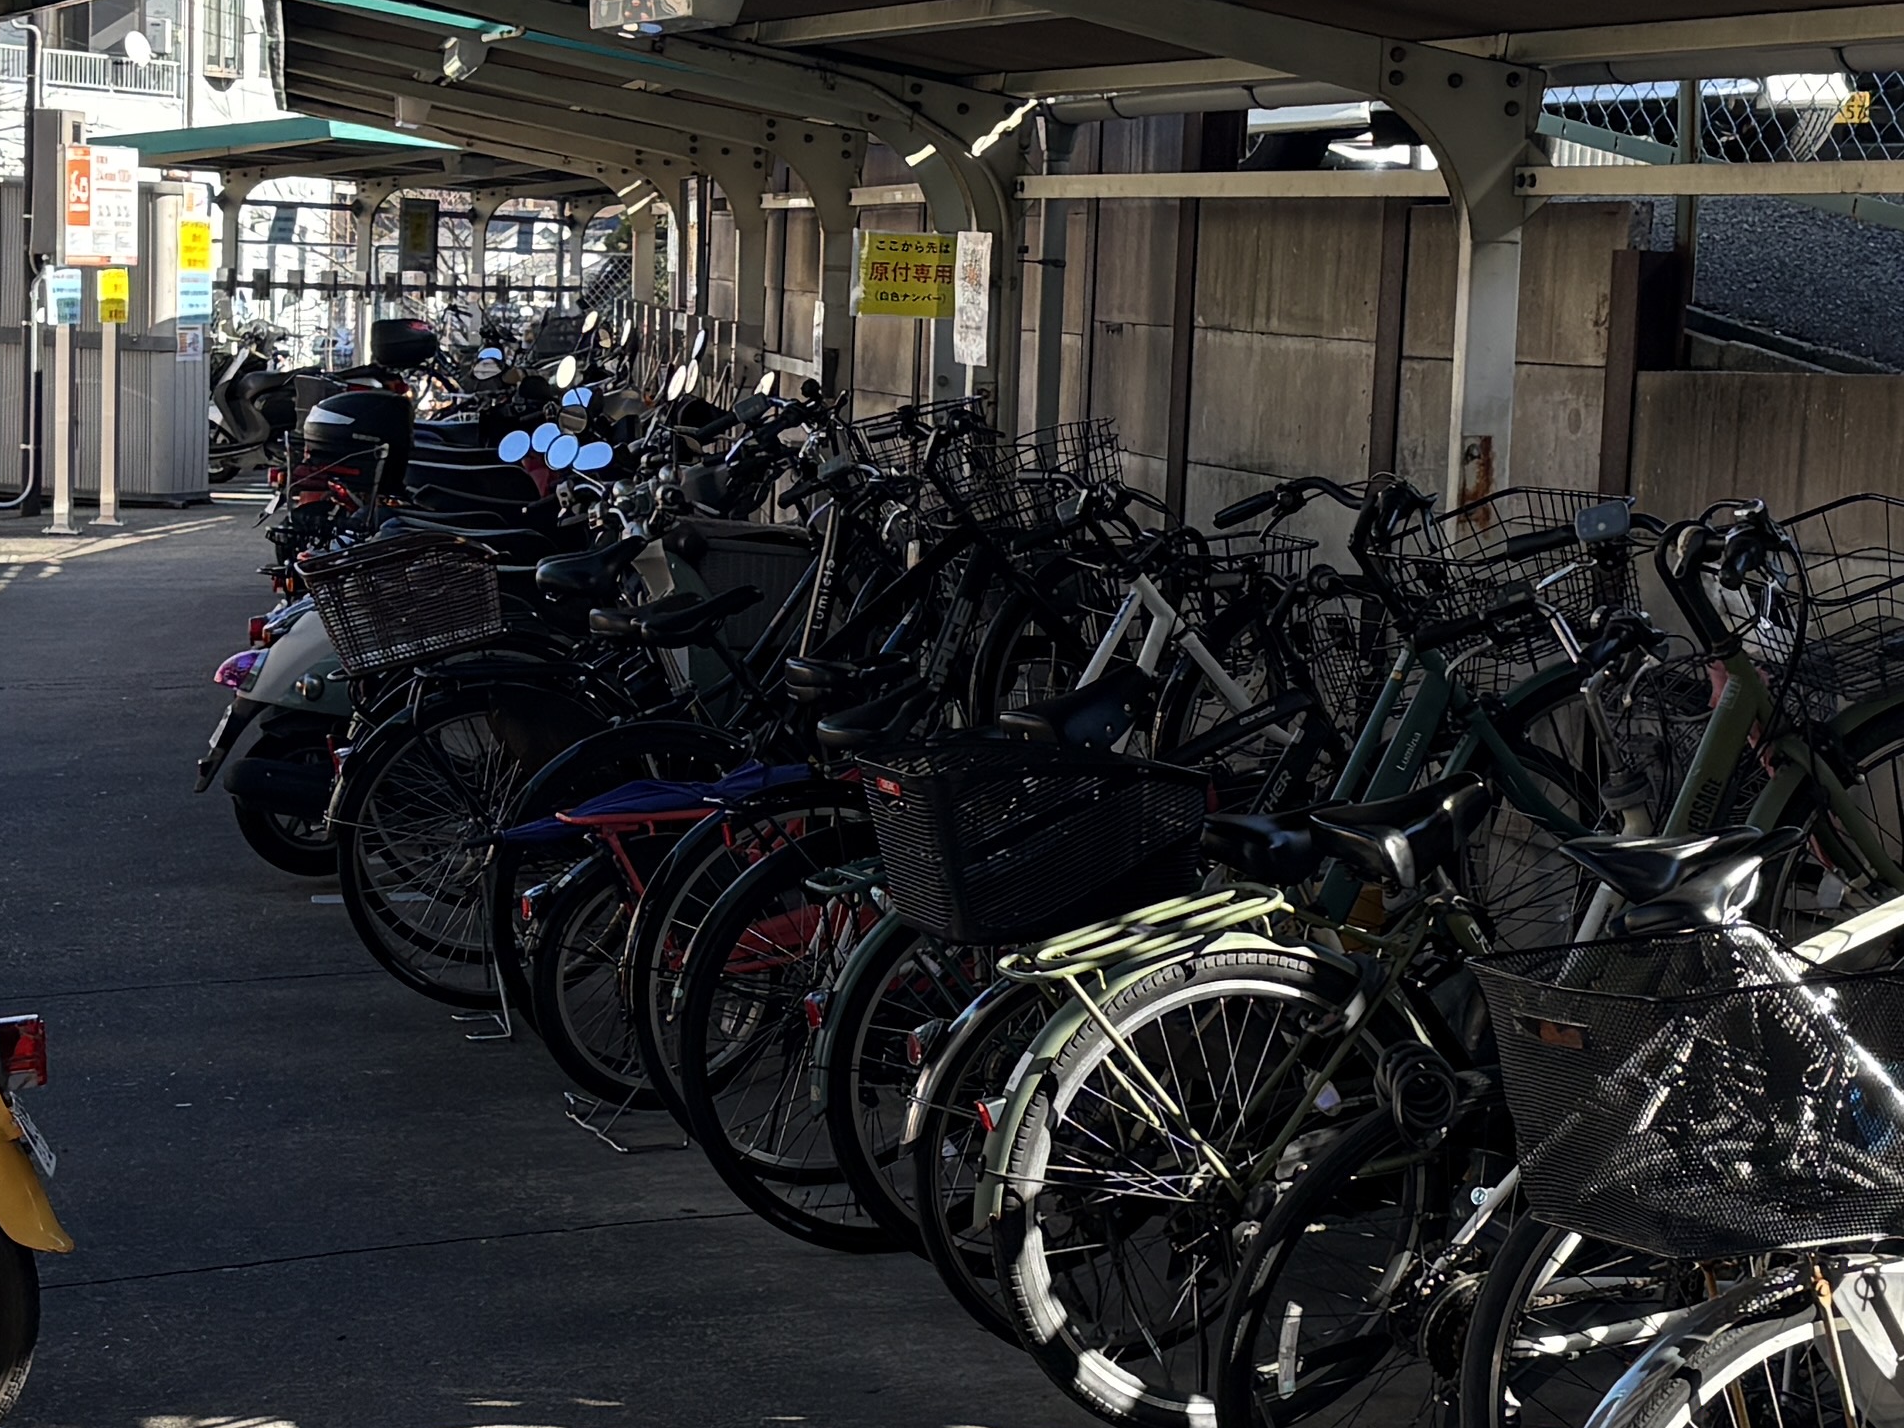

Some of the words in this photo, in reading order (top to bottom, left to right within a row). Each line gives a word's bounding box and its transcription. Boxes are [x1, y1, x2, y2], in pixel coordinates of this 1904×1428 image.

[877, 240, 952, 254] ここから先は
[869, 262, 953, 284] 原付専用
